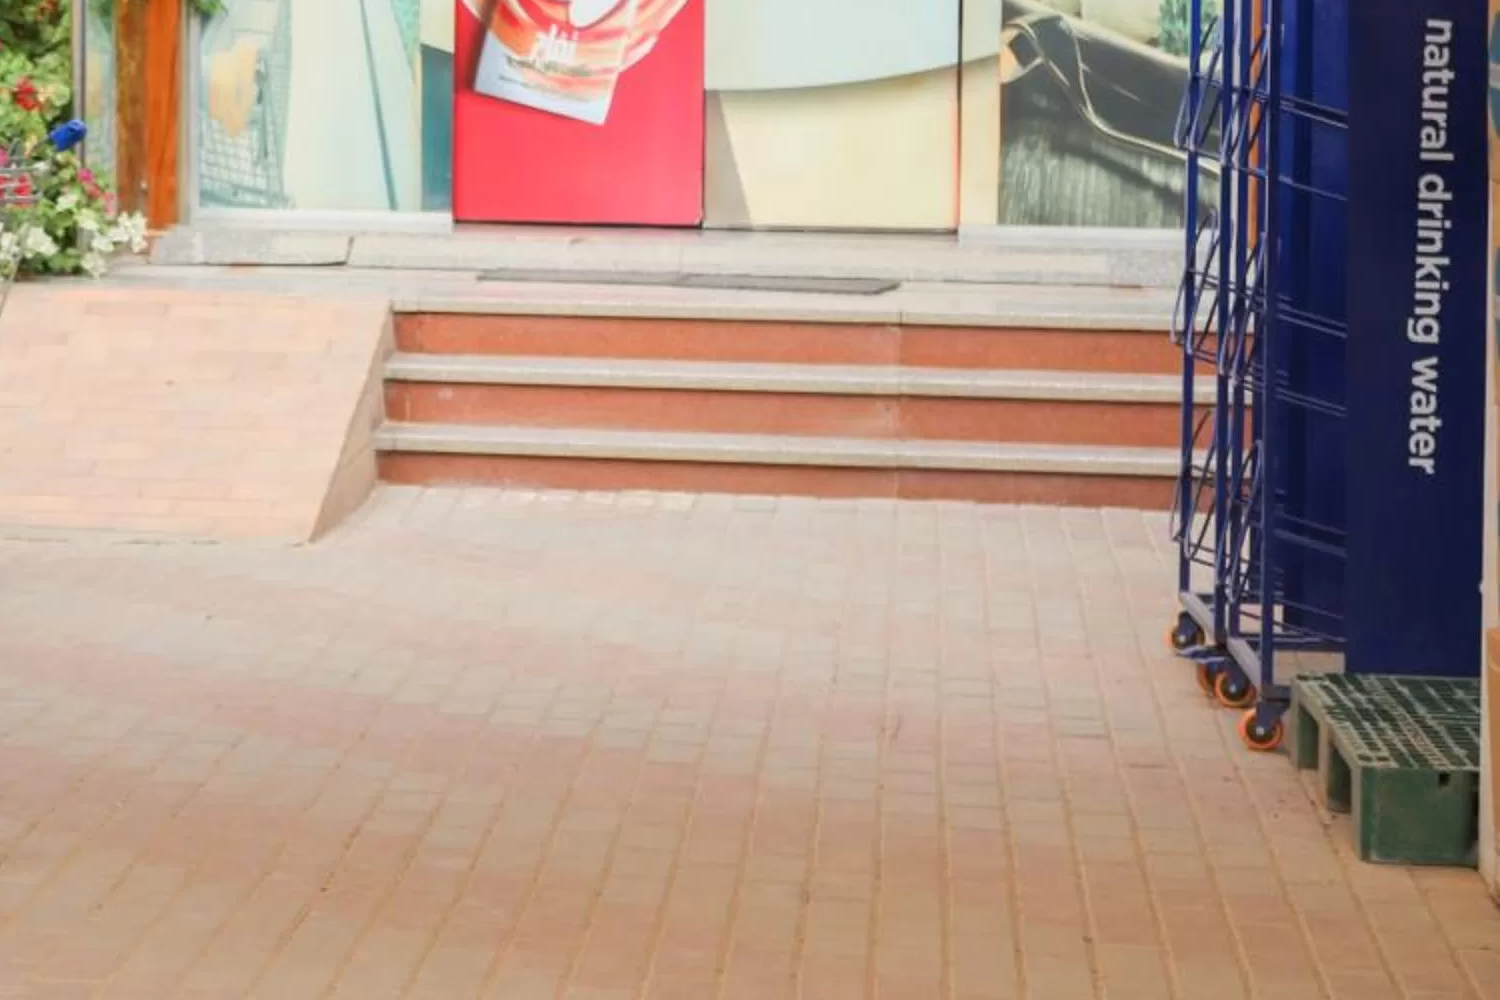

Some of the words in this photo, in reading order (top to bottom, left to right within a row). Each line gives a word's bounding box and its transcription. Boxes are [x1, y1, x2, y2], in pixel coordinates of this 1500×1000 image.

[1419, 18, 1454, 162] natural
[1407, 173, 1453, 345] drinking
[1407, 355, 1443, 475] water
